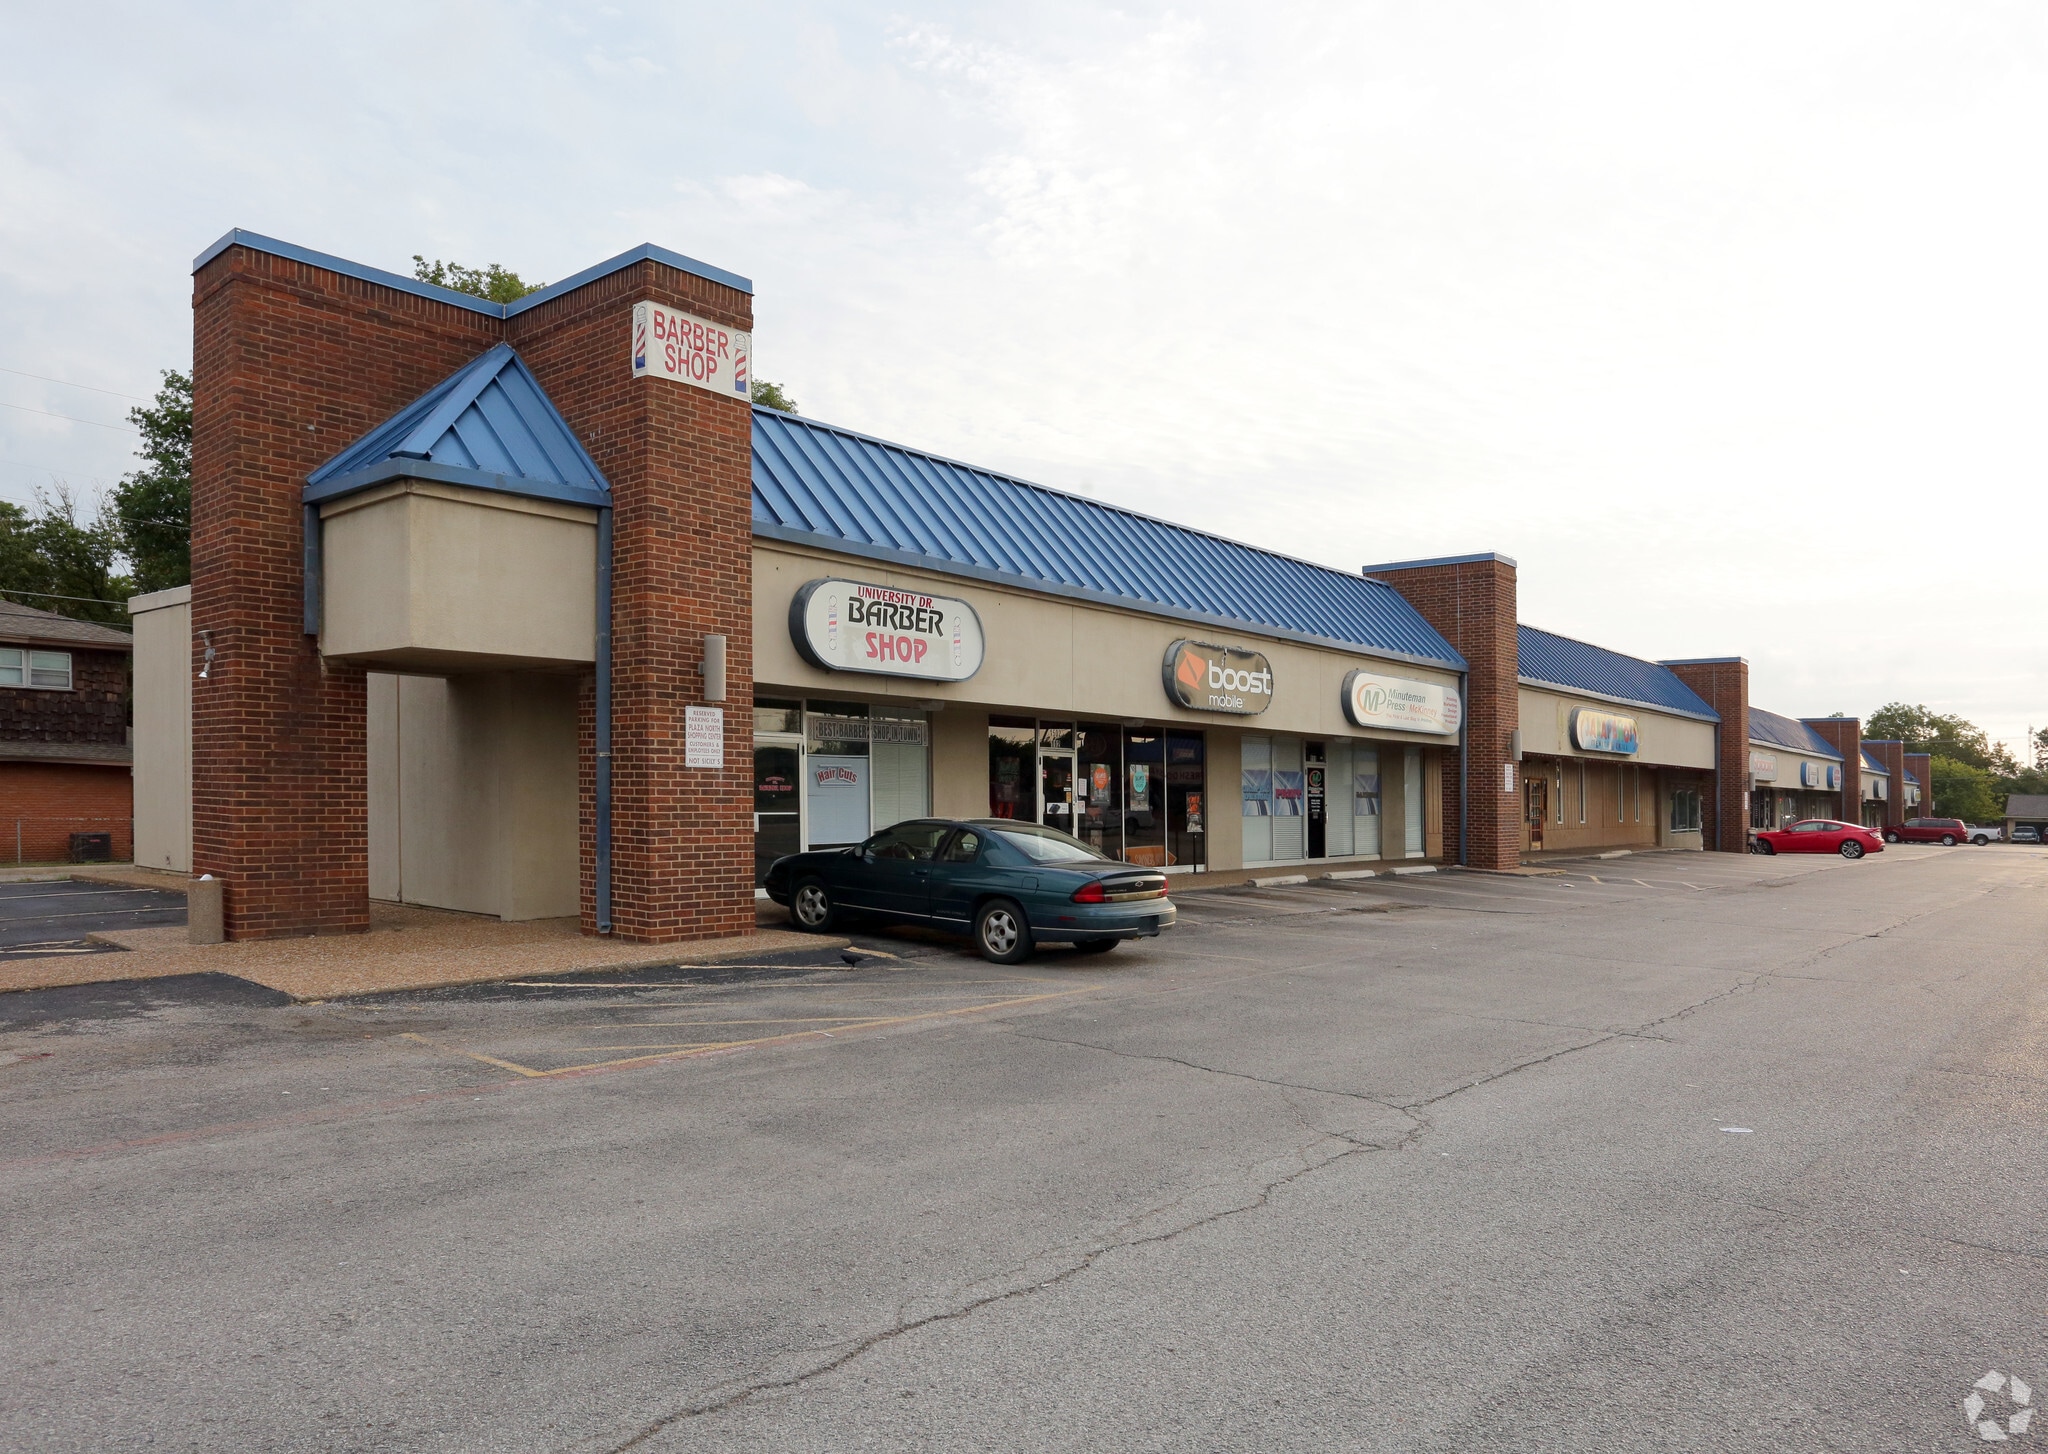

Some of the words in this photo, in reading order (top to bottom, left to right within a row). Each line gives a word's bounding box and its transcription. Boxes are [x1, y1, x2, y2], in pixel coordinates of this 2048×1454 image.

[654, 310, 729, 360] BARBER
[665, 344, 718, 383] SHOP
[857, 586, 917, 606] UNIVERSITY
[918, 596, 935, 609] DR.
[848, 596, 944, 638] BARBER
[865, 631, 928, 664] SHOP
[1208, 659, 1271, 695] boost
[1209, 694, 1244, 708] mobile
[1388, 688, 1426, 704] Minuteman
[1387, 698, 1406, 711] Press
[1409, 703, 1438, 718] McKinney
[708, 732, 721, 740] CENTER
[819, 722, 837, 738] BEST
[840, 723, 867, 739] BARBER
[873, 724, 890, 740] SHOP
[891, 725, 898, 741] IN
[900, 726, 918, 741] TOWN
[817, 767, 836, 782] Hair
[838, 767, 857, 783] Cuts
